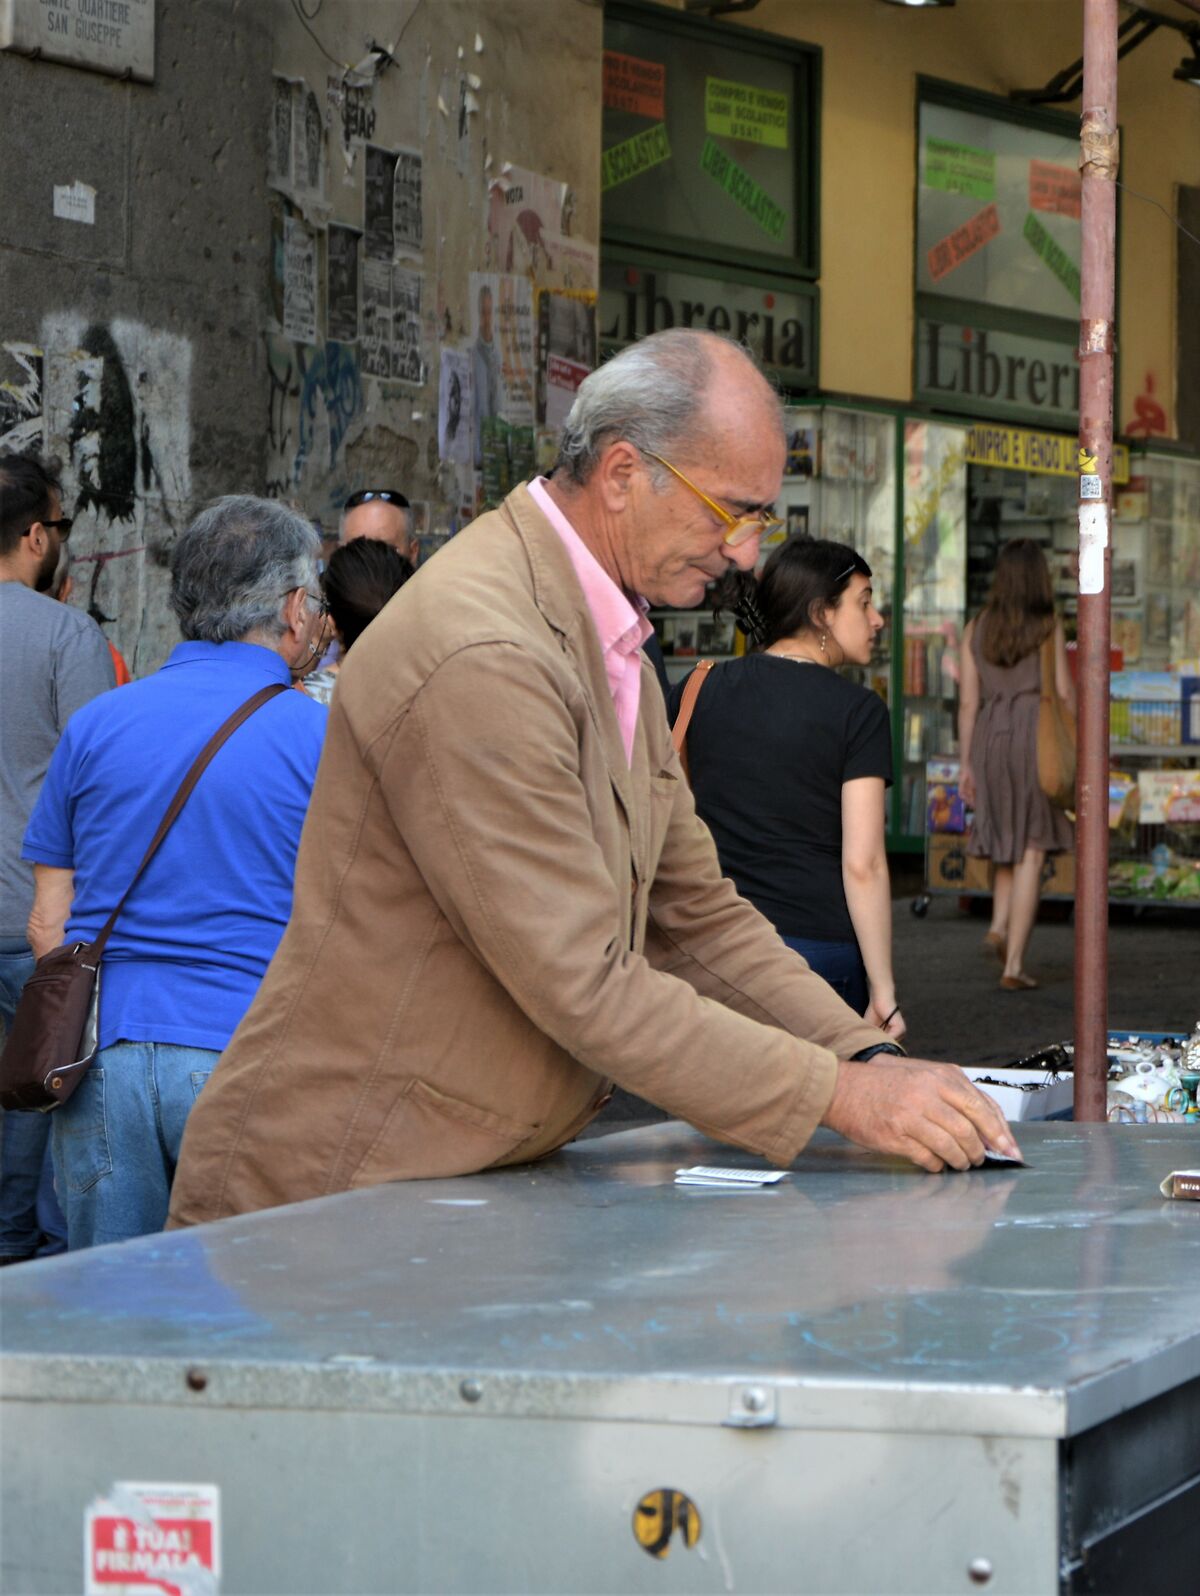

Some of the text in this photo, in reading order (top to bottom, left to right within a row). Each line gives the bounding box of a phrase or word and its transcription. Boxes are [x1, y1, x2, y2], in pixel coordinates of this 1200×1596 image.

[47, 11, 123, 49] SAN GIUSEPPE
[505, 186, 524, 204] VOTA
